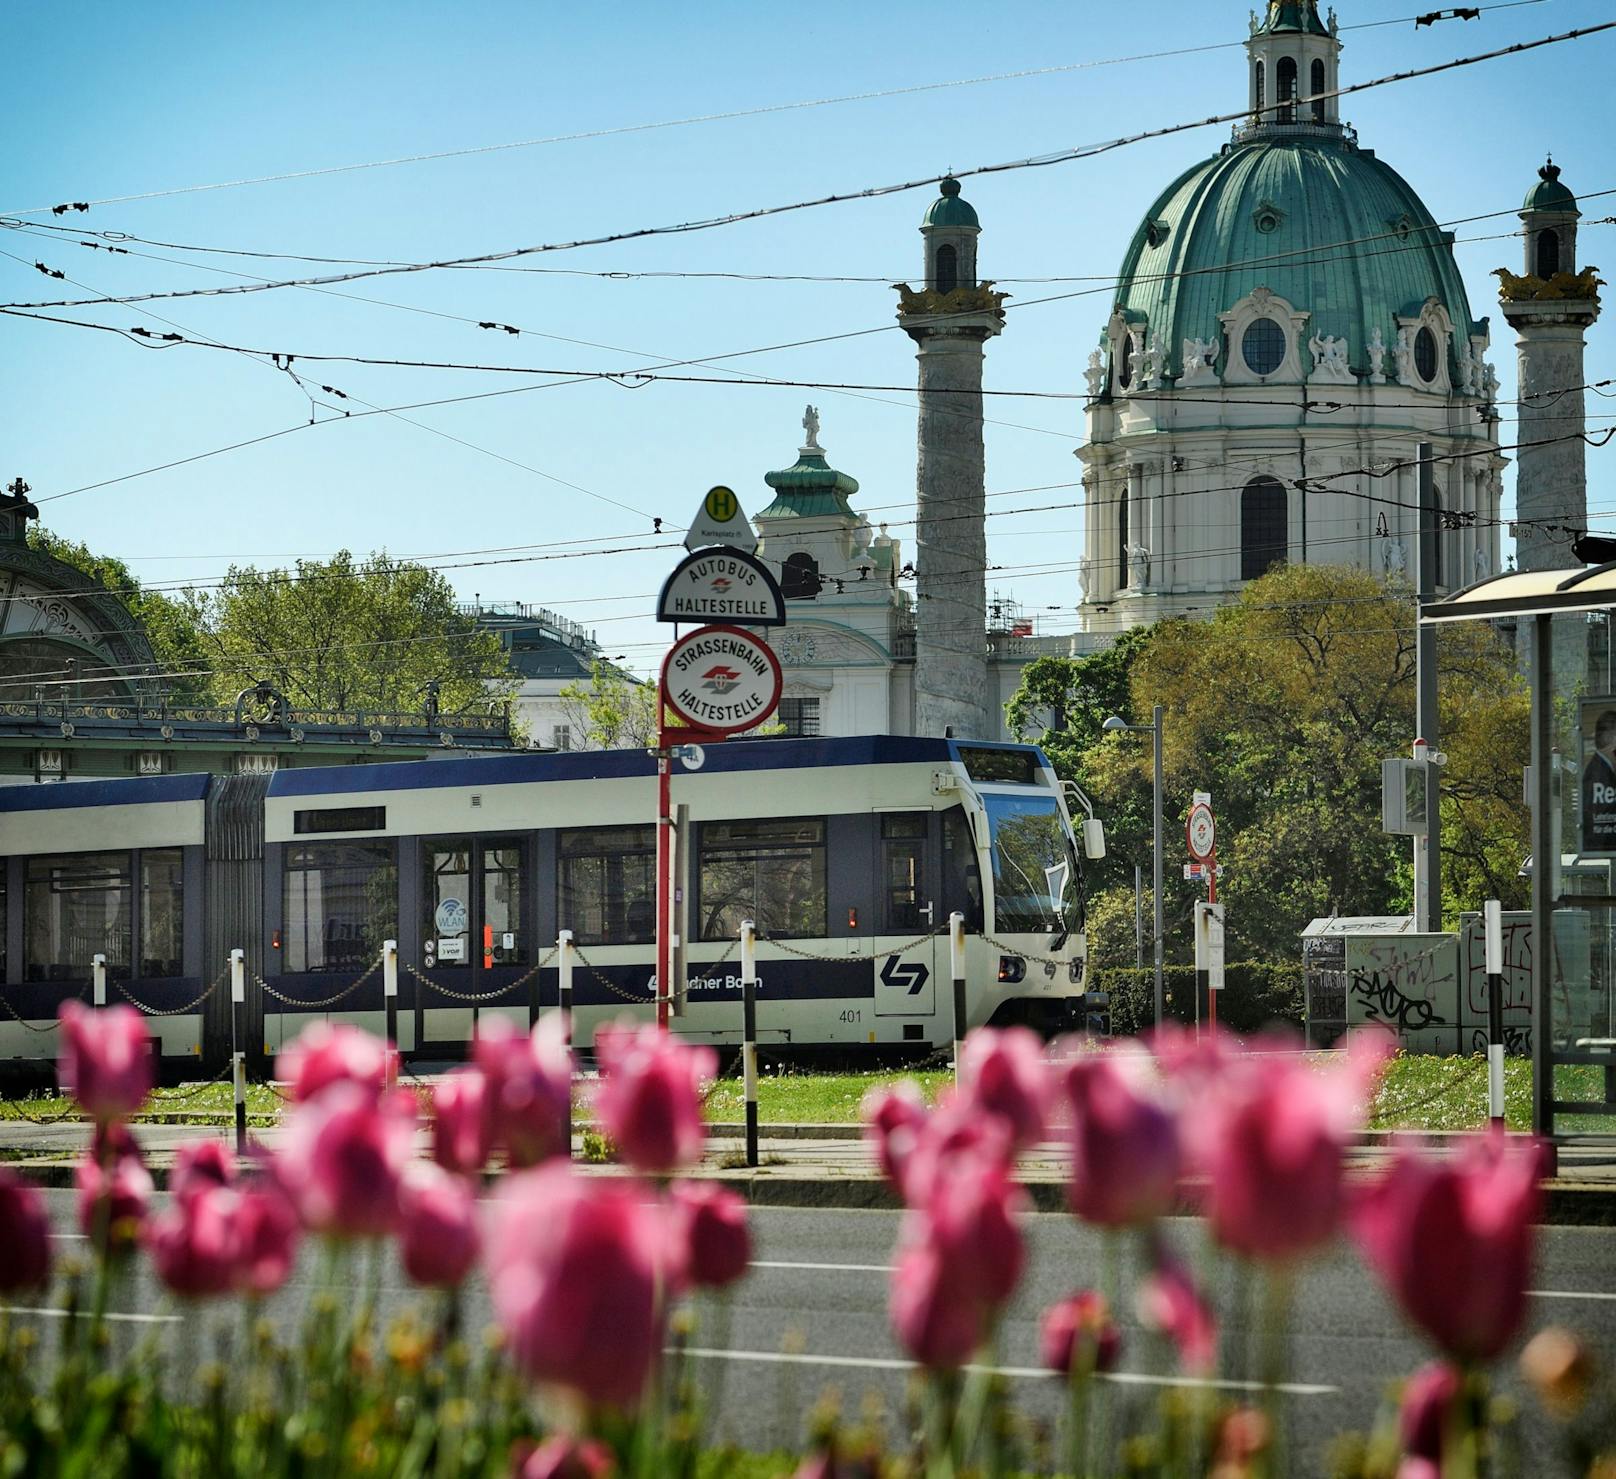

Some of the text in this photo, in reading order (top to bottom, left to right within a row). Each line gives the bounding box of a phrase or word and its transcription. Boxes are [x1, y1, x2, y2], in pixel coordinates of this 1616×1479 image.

[713, 493, 729, 516] H
[689, 559, 756, 586] AUTOBUS
[675, 597, 767, 615] HALTESTELLE
[675, 638, 769, 677] STRASSENBAHN
[677, 688, 764, 721] HALTESTELLE
[1592, 782, 1616, 804] Re
[438, 917, 464, 928] WLAN
[839, 1009, 861, 1023] 401
